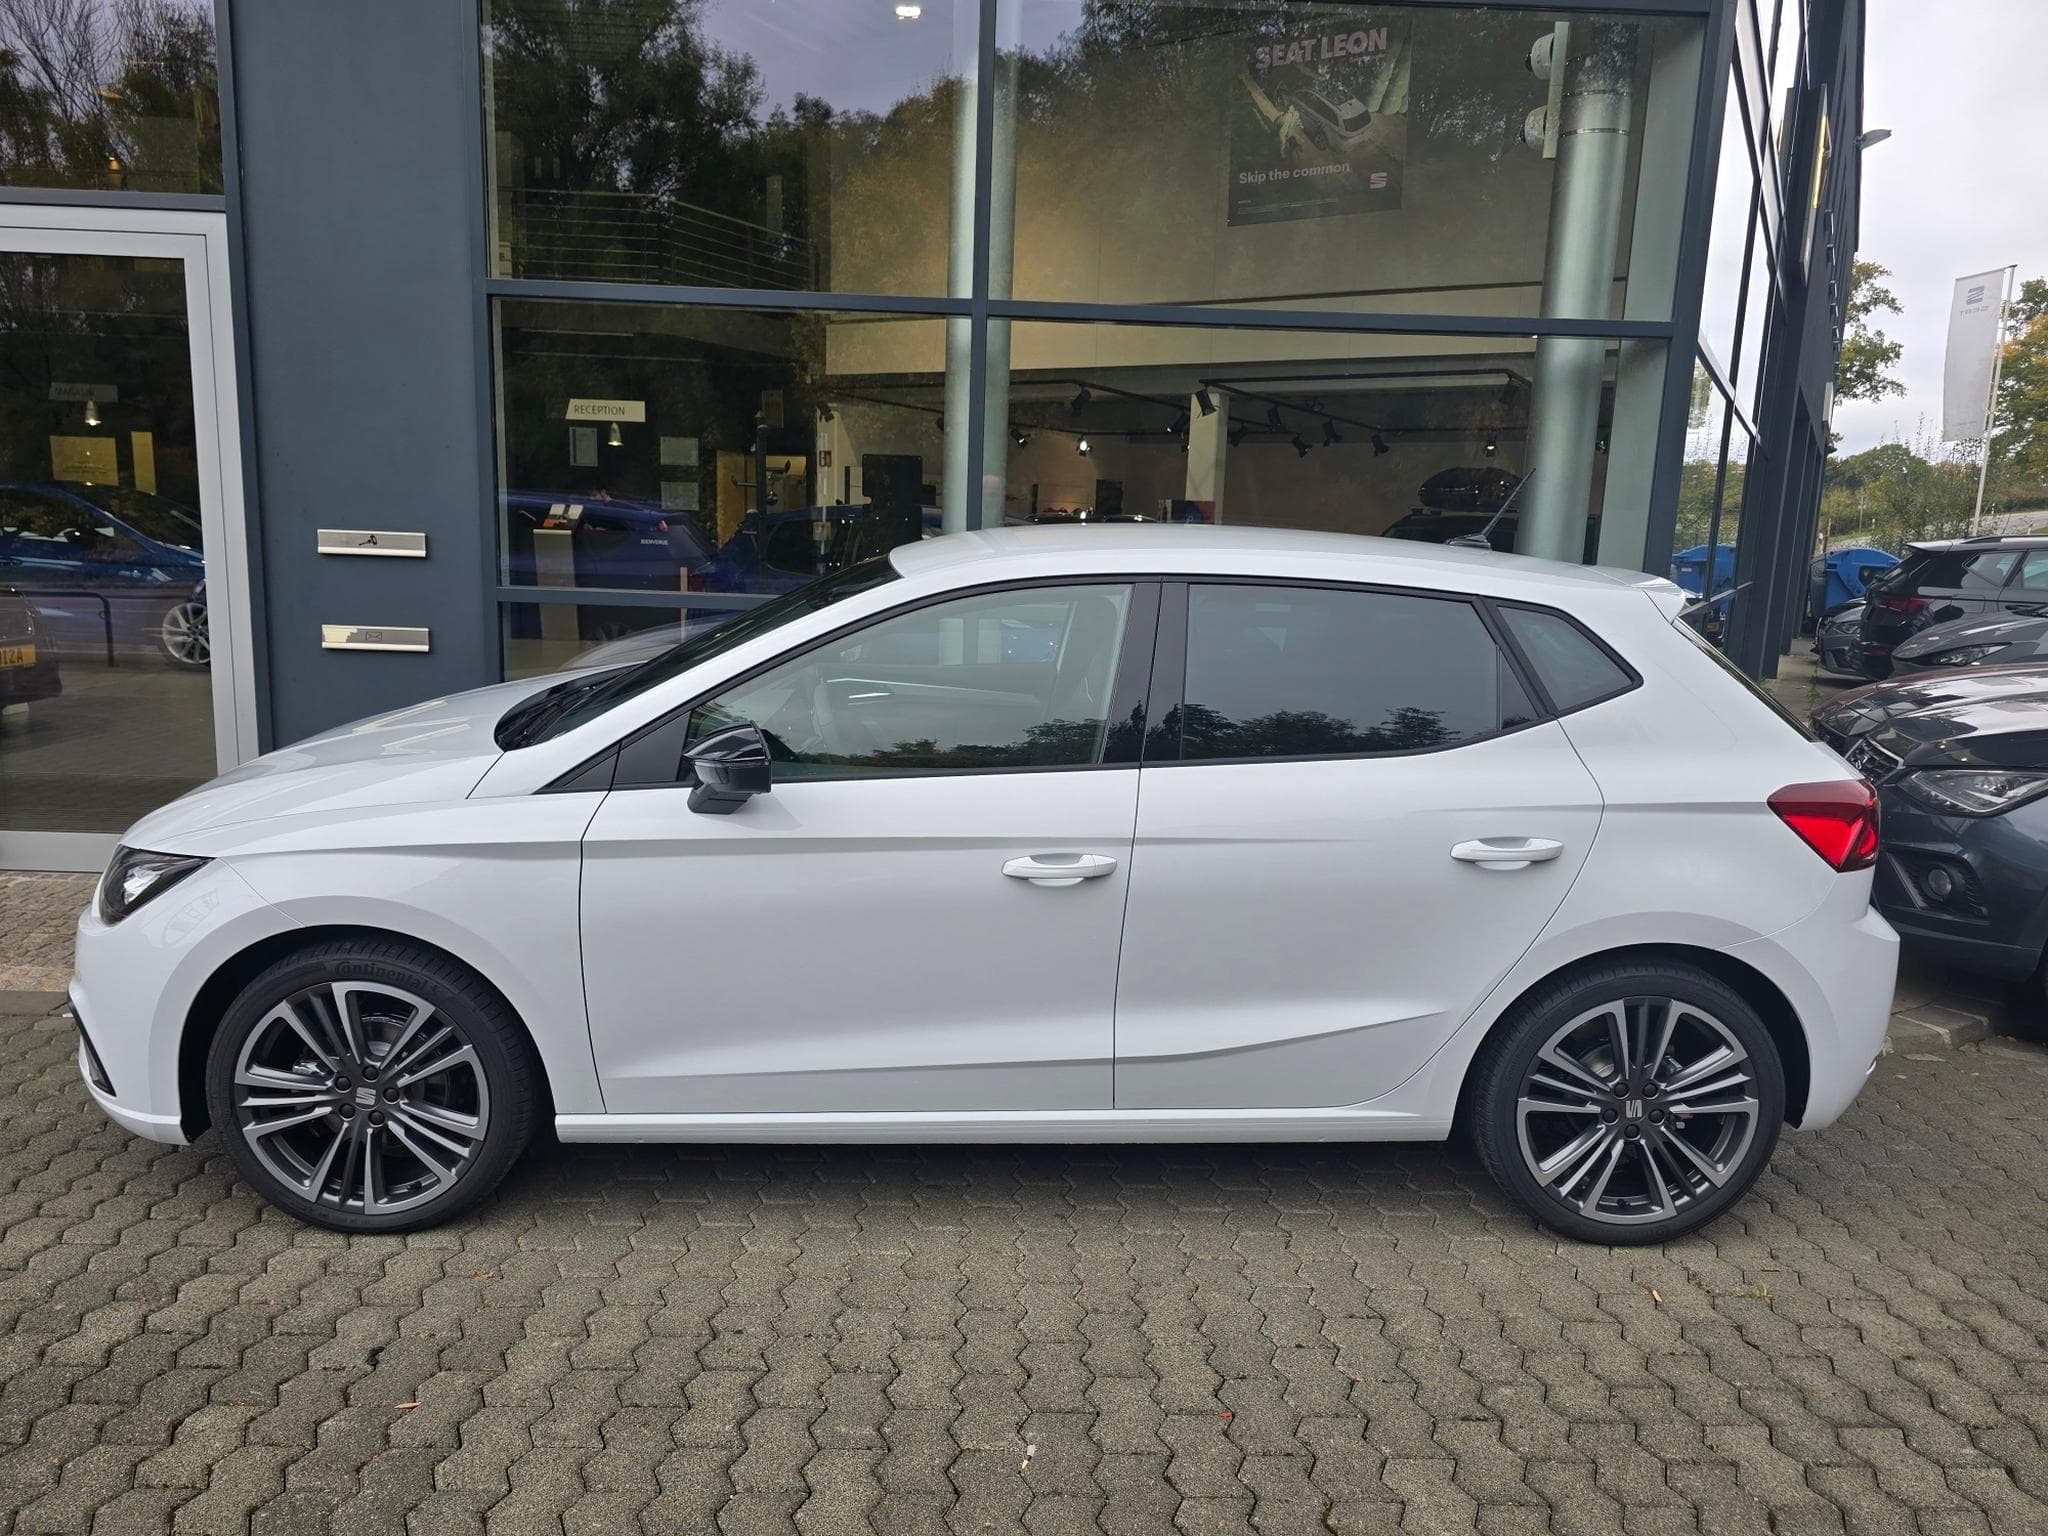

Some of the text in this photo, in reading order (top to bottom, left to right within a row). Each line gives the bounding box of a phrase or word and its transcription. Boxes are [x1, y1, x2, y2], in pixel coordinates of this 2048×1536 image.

[1255, 27, 1388, 69] SEAT LEON
[1239, 162, 1350, 184] Skip the common
[574, 404, 625, 416] RECEPTION
[0, 648, 24, 665] IZA
[335, 961, 429, 990] Continental
